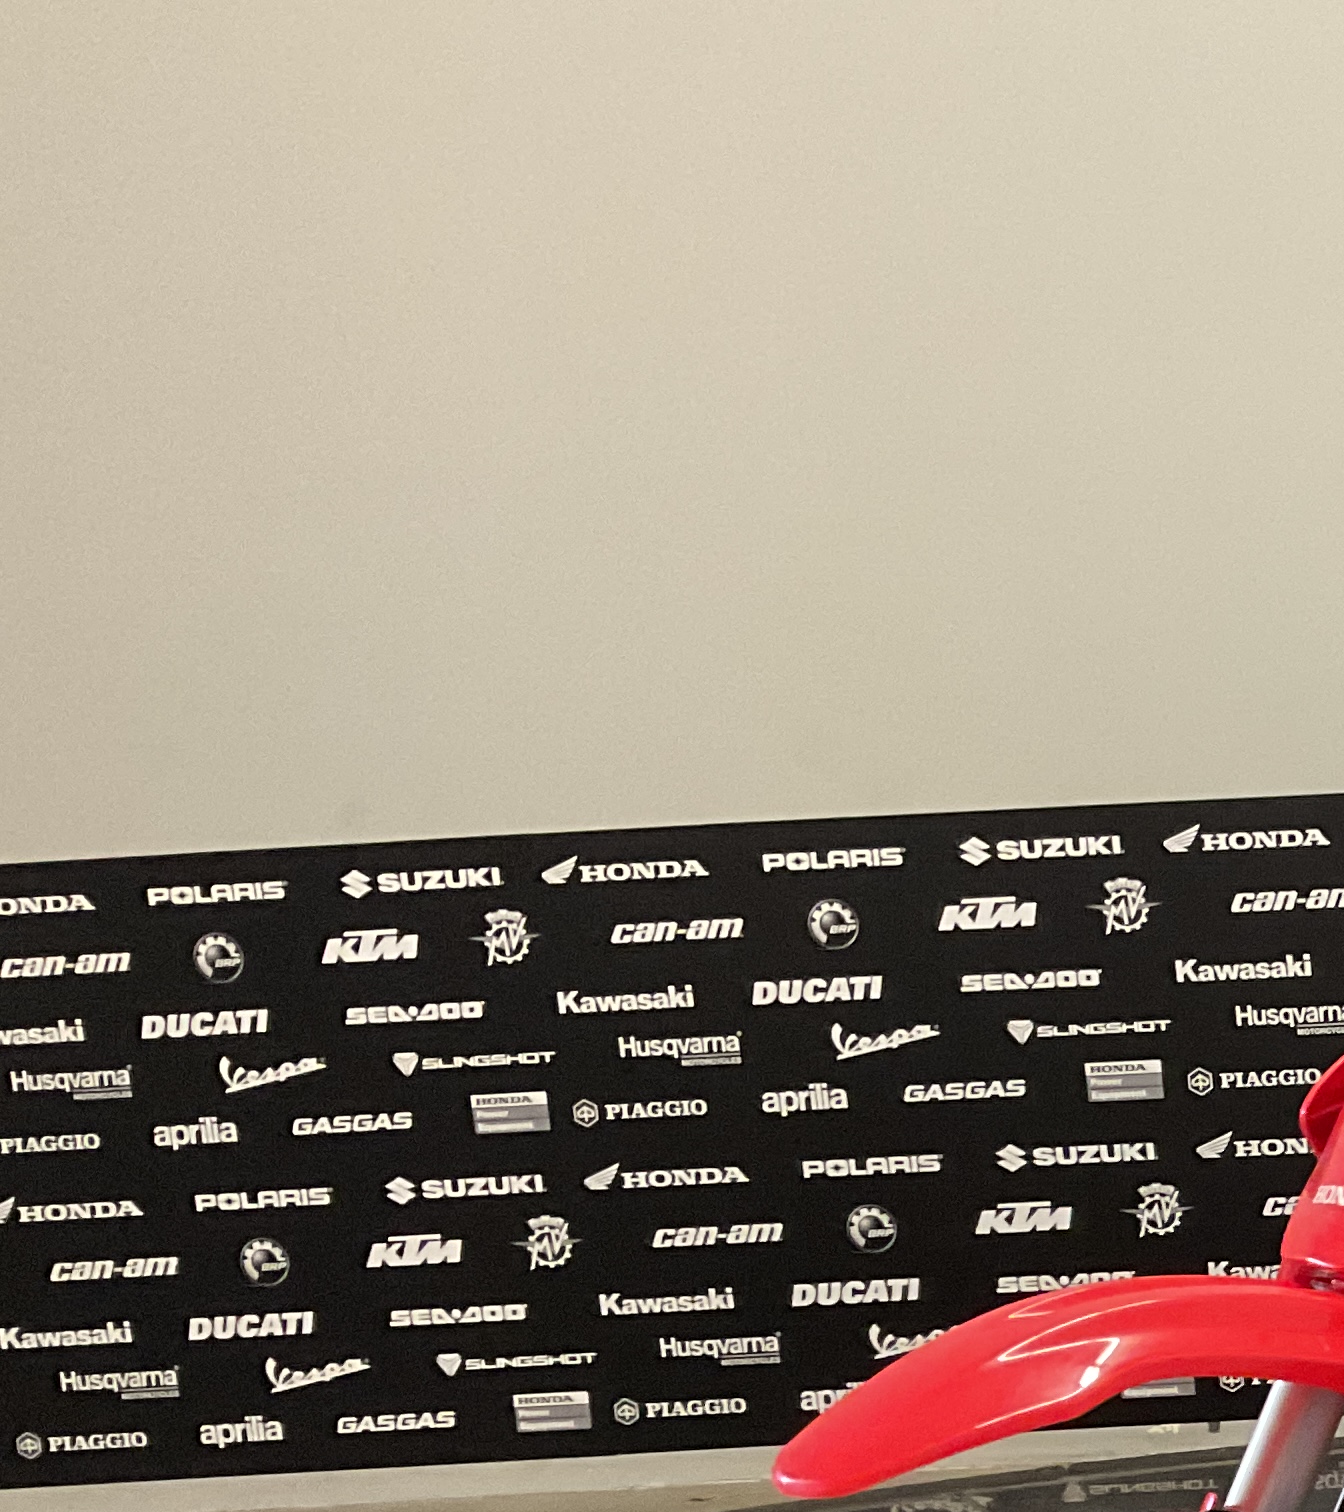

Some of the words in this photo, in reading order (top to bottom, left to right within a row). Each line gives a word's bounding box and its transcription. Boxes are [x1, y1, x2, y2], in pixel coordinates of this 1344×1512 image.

[995, 834, 1126, 861] SUZUKI
[1200, 828, 1331, 852] HONDA
[577, 859, 710, 883] HONDA
[761, 846, 907, 873] POLARIS
[376, 866, 505, 893] SUZUKI
[0, 894, 97, 916] ONDA
[146, 880, 288, 907] POLARIS
[937, 895, 1038, 932] KTM
[610, 917, 744, 945] can-am
[321, 927, 419, 965] KTM
[0, 951, 131, 979] can-am
[1174, 953, 1313, 983] Kawasaki
[556, 983, 695, 1015] Kawasaki
[751, 975, 883, 1006] DUCATI
[140, 1008, 269, 1040] DUCATI
[1036, 1019, 1172, 1038] SLINGSHOT
[617, 1031, 740, 1060] Husqvarna
[830, 1022, 941, 1061] Vespa
[421, 1050, 557, 1071] SLINGSHOT
[1090, 1063, 1146, 1073] HONDA
[9, 1065, 130, 1094] Husqvarna
[218, 1055, 327, 1094] Vespa
[1218, 1067, 1322, 1089] PIAGGIO
[475, 1095, 532, 1106] HONDA
[761, 1082, 849, 1118] aprilia
[902, 1078, 1027, 1103] GASGAS
[603, 1098, 708, 1121] PIAGGIO
[152, 1116, 239, 1151] aprilia
[291, 1111, 413, 1136] GASGAS
[0, 1133, 101, 1155] PIAGGIO
[1032, 1142, 1159, 1167] SUZUKI
[1233, 1137, 1313, 1158] HON
[620, 1166, 750, 1189] HONDA
[801, 1153, 944, 1179] POLARIS
[420, 1173, 548, 1199] SUZUKI
[16, 1200, 145, 1223] HONDA
[194, 1187, 334, 1213] POLARIS
[974, 1200, 1073, 1235] KTM
[651, 1222, 784, 1249] can-am
[365, 1233, 463, 1269] KTM
[49, 1256, 179, 1282] can-am
[598, 1286, 735, 1316] Kawasaki
[791, 1277, 920, 1308] DUCATI
[0, 1320, 133, 1350] Kawasaki
[187, 1310, 314, 1341] DUCATI
[658, 1332, 779, 1359] Husqvarna
[264, 1356, 372, 1394] Vespa
[464, 1352, 598, 1371] SLINGSHOT
[59, 1365, 177, 1393] Husqvarna
[644, 1397, 747, 1419] PIAGGIO
[199, 1414, 284, 1449] aprilia
[336, 1410, 457, 1434] GASGAS
[46, 1431, 148, 1453] PIAGGIO
